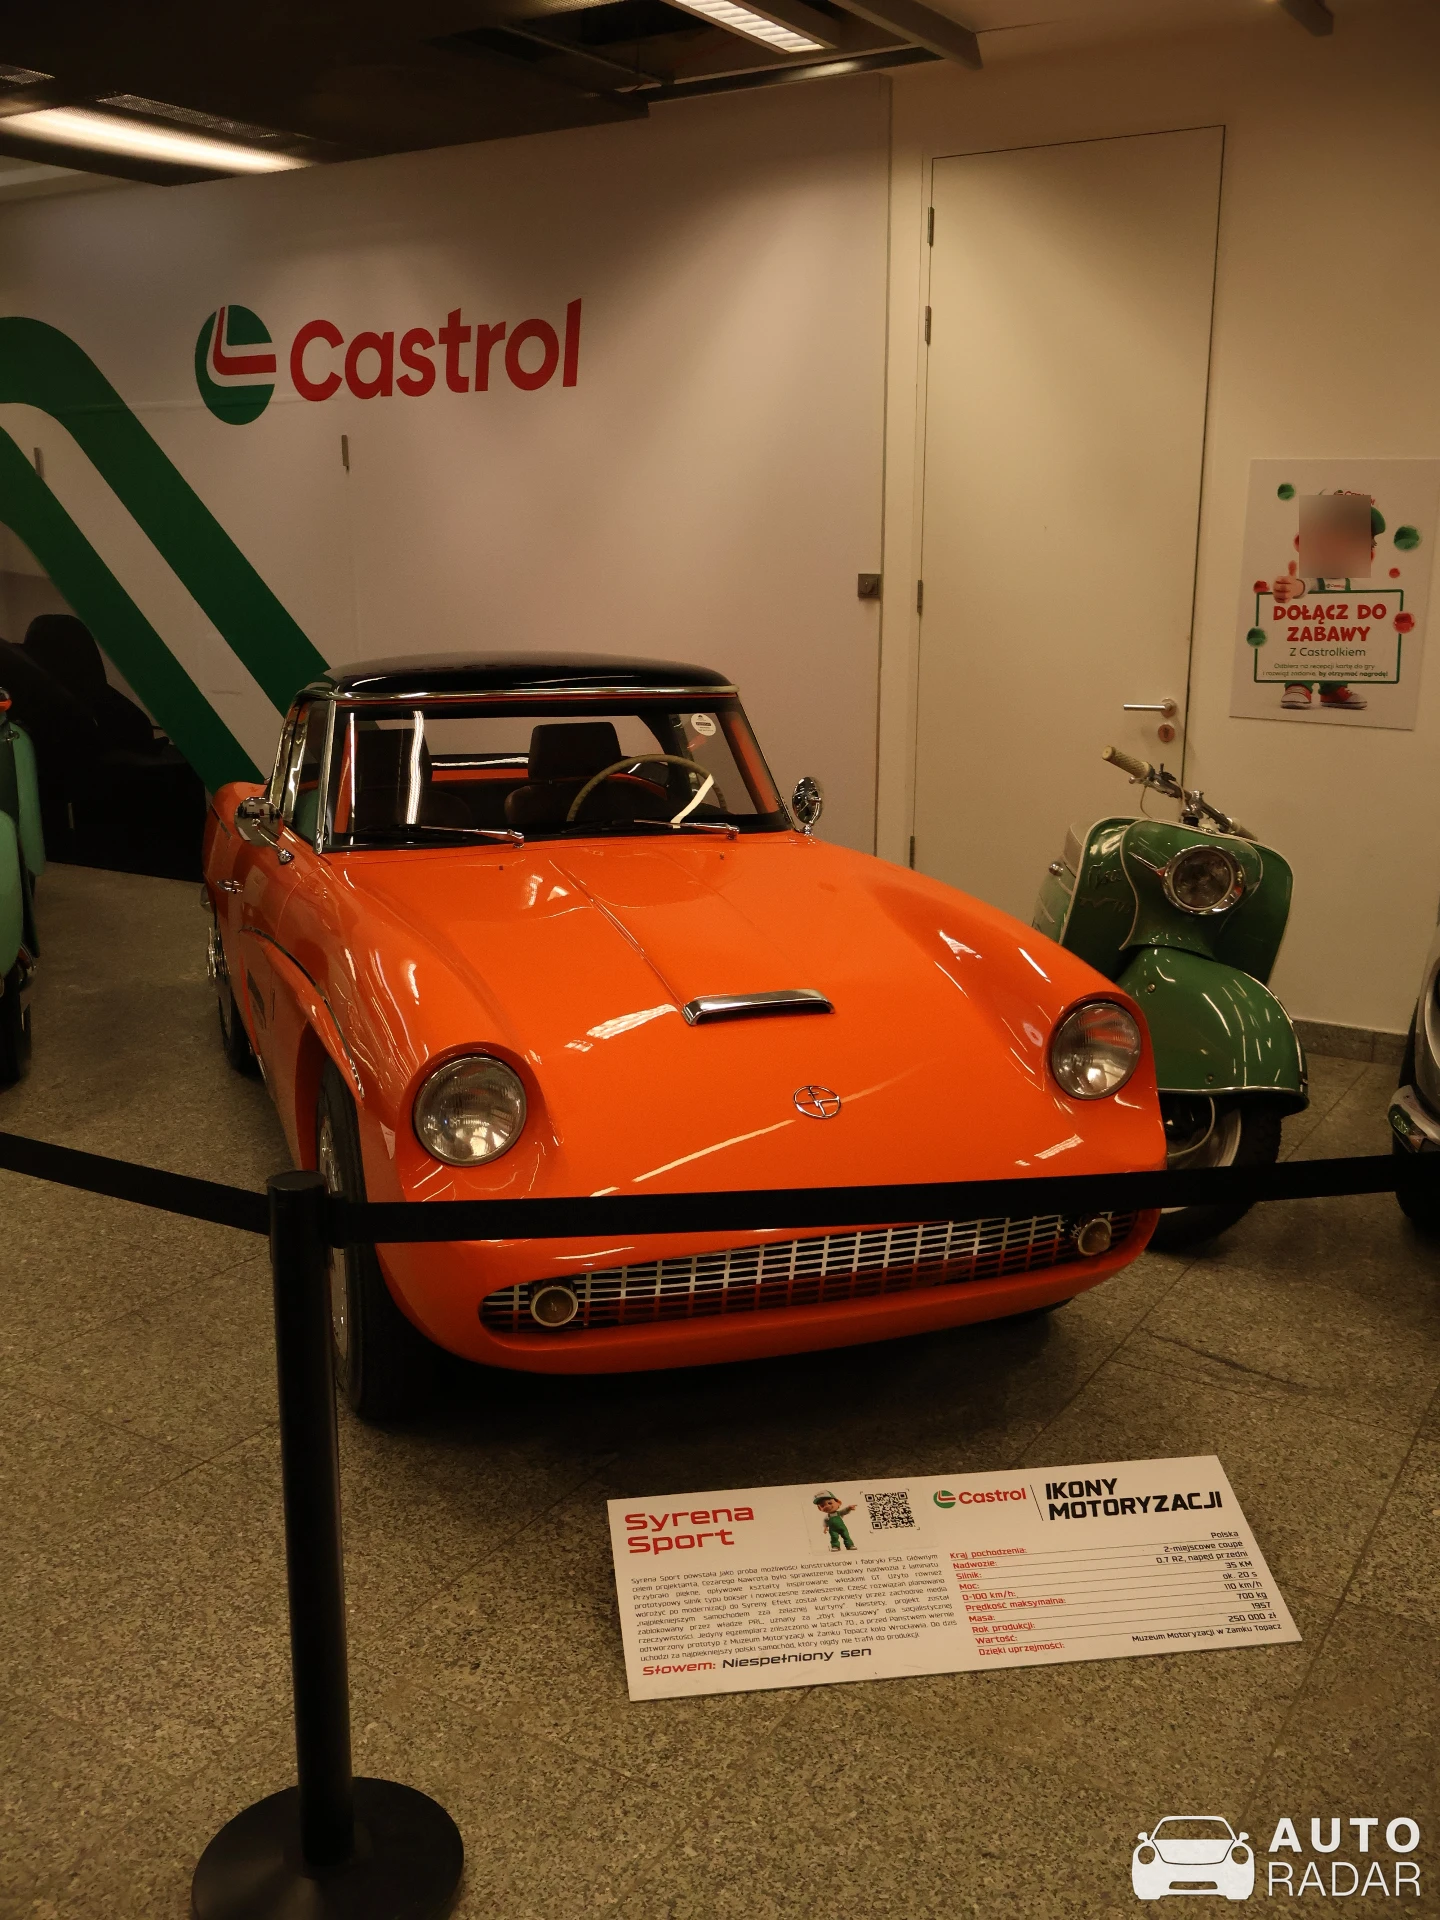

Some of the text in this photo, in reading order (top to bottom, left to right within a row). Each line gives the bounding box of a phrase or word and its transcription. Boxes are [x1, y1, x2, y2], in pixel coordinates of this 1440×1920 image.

[290, 298, 582, 401] Castrol
[1273, 604, 1386, 624] DOŁĄCZ DO
[1287, 626, 1370, 642] ZABAWY
[1290, 647, 1365, 656] Z Castrolkiem
[1045, 1478, 1118, 1500] IKONY
[958, 1488, 1027, 1505] Castrol
[1049, 1491, 1223, 1520] MOTORYZACJI
[625, 1507, 754, 1532] Syrena
[628, 1529, 734, 1555] Sport
[1164, 1543, 1216, 1552] 2-miejscowe
[972, 1547, 1027, 1558] pochodzenia:
[1188, 1553, 1214, 1562] napęd
[1216, 1550, 1248, 1560] przedni
[953, 1560, 997, 1569] Nadwozie:
[990, 1590, 1016, 1599] km/h:
[965, 1597, 1066, 1611] Prędkość maksymalna:
[992, 1622, 1035, 1633] produkcji:
[976, 1635, 1018, 1644] Wartość:
[1132, 1633, 1165, 1642] Muzeum
[1167, 1630, 1215, 1639] Motoryzacji
[979, 1642, 1065, 1656] Dzięki uprzejmości:
[642, 1648, 872, 1676] Słowem: Niespełniony sen
